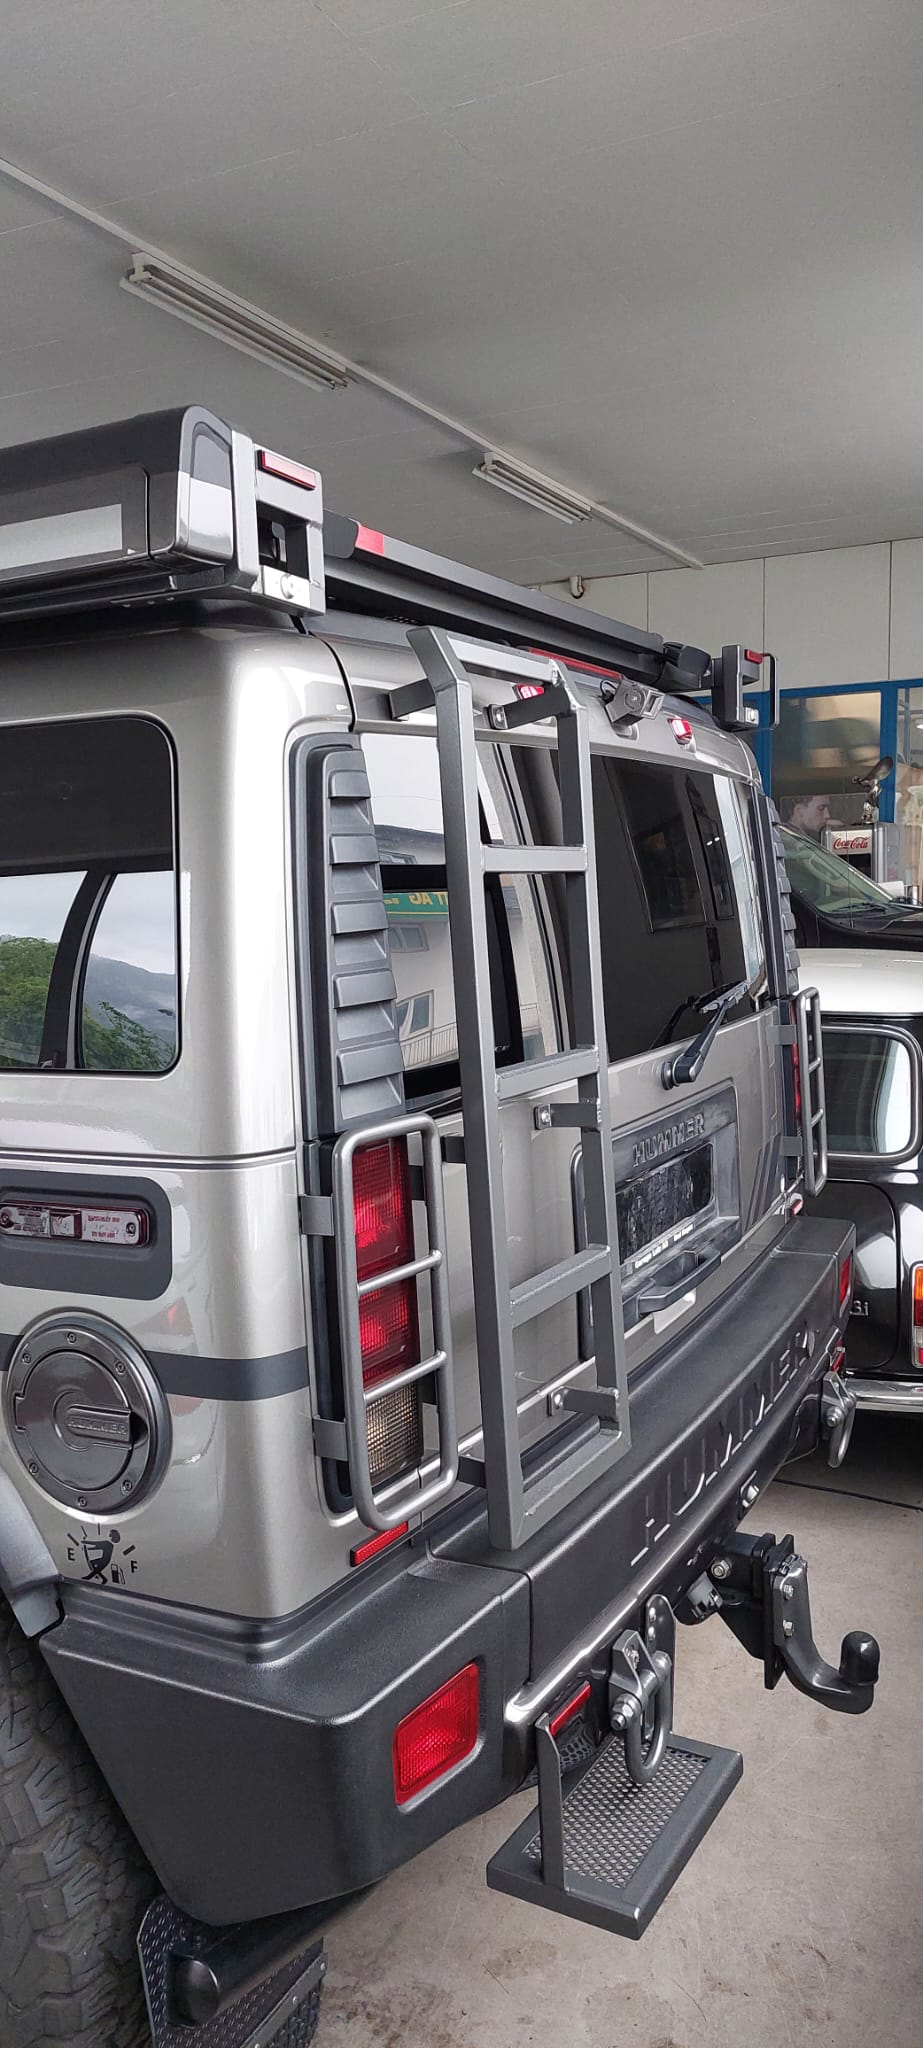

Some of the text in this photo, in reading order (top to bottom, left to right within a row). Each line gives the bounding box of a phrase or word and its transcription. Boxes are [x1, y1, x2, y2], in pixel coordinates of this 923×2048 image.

[632, 1113, 705, 1168] HUMMER
[631, 1324, 815, 1566] HUMMER
[67, 1547, 75, 1561] E
[130, 1560, 138, 1574] F
